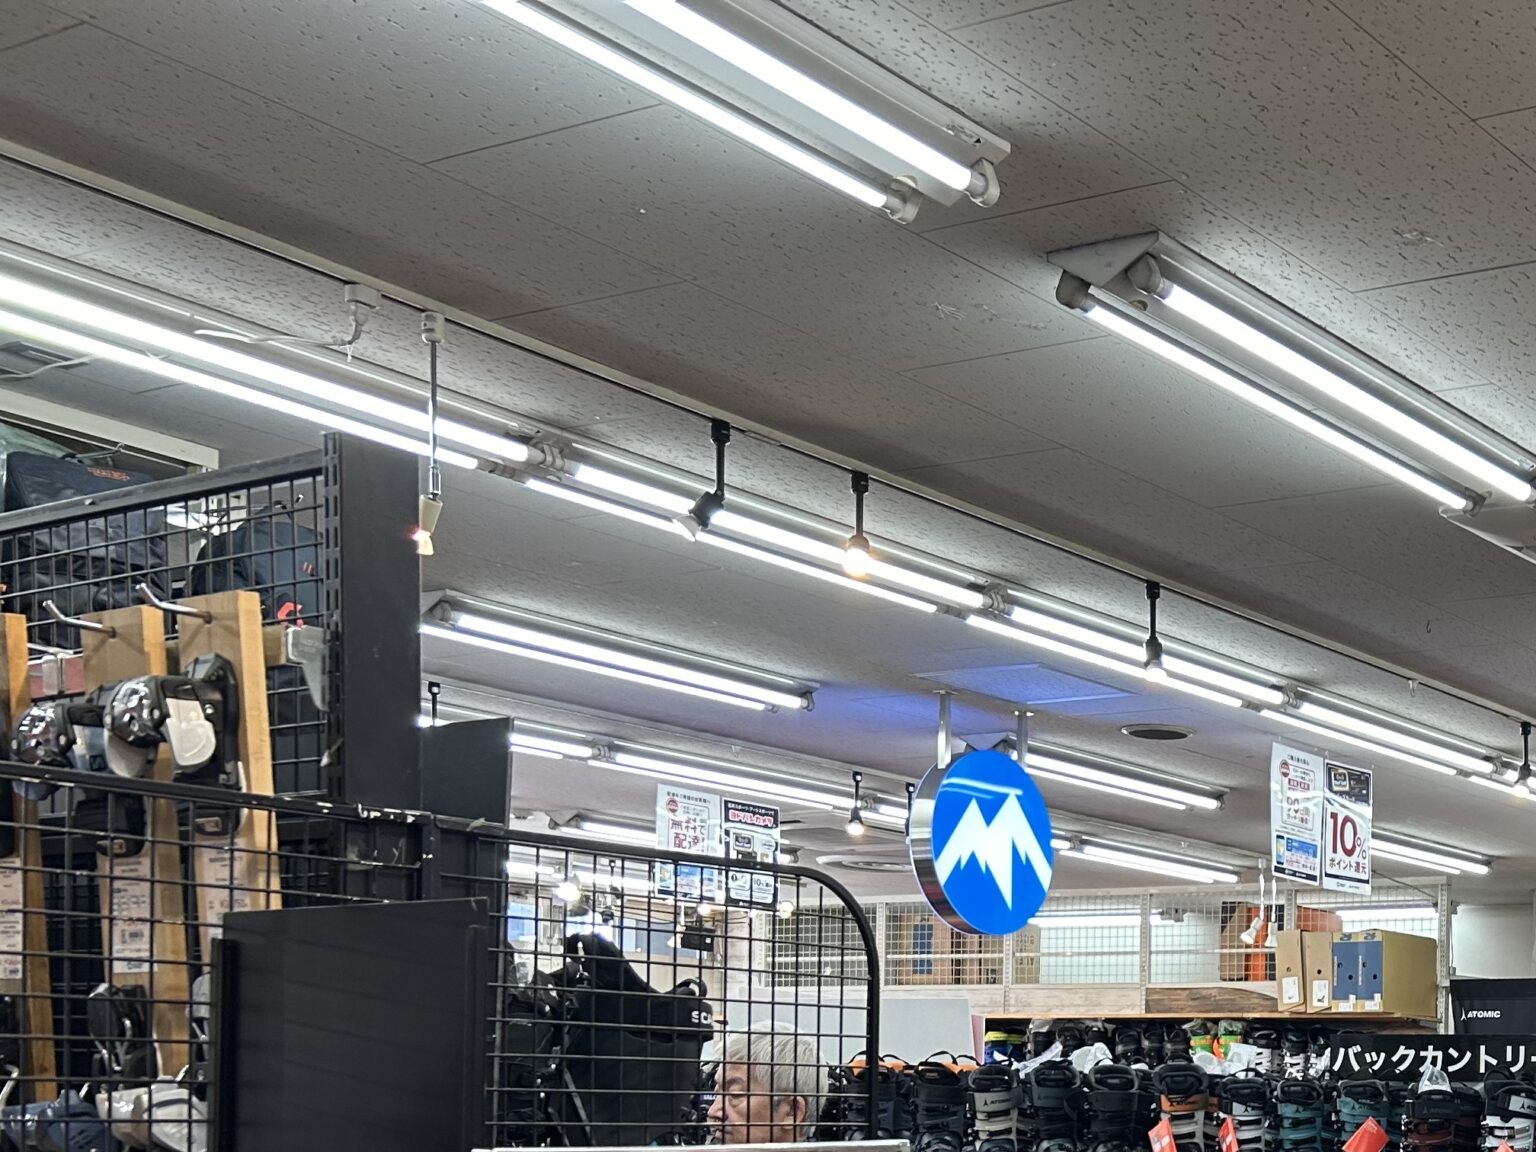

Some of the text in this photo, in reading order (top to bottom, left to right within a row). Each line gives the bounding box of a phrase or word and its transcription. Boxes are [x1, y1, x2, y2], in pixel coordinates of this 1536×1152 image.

[1330, 811, 1367, 860] 10%
[1329, 858, 1367, 875] ポイント還元
[1468, 1009, 1501, 1019] ATOMIC
